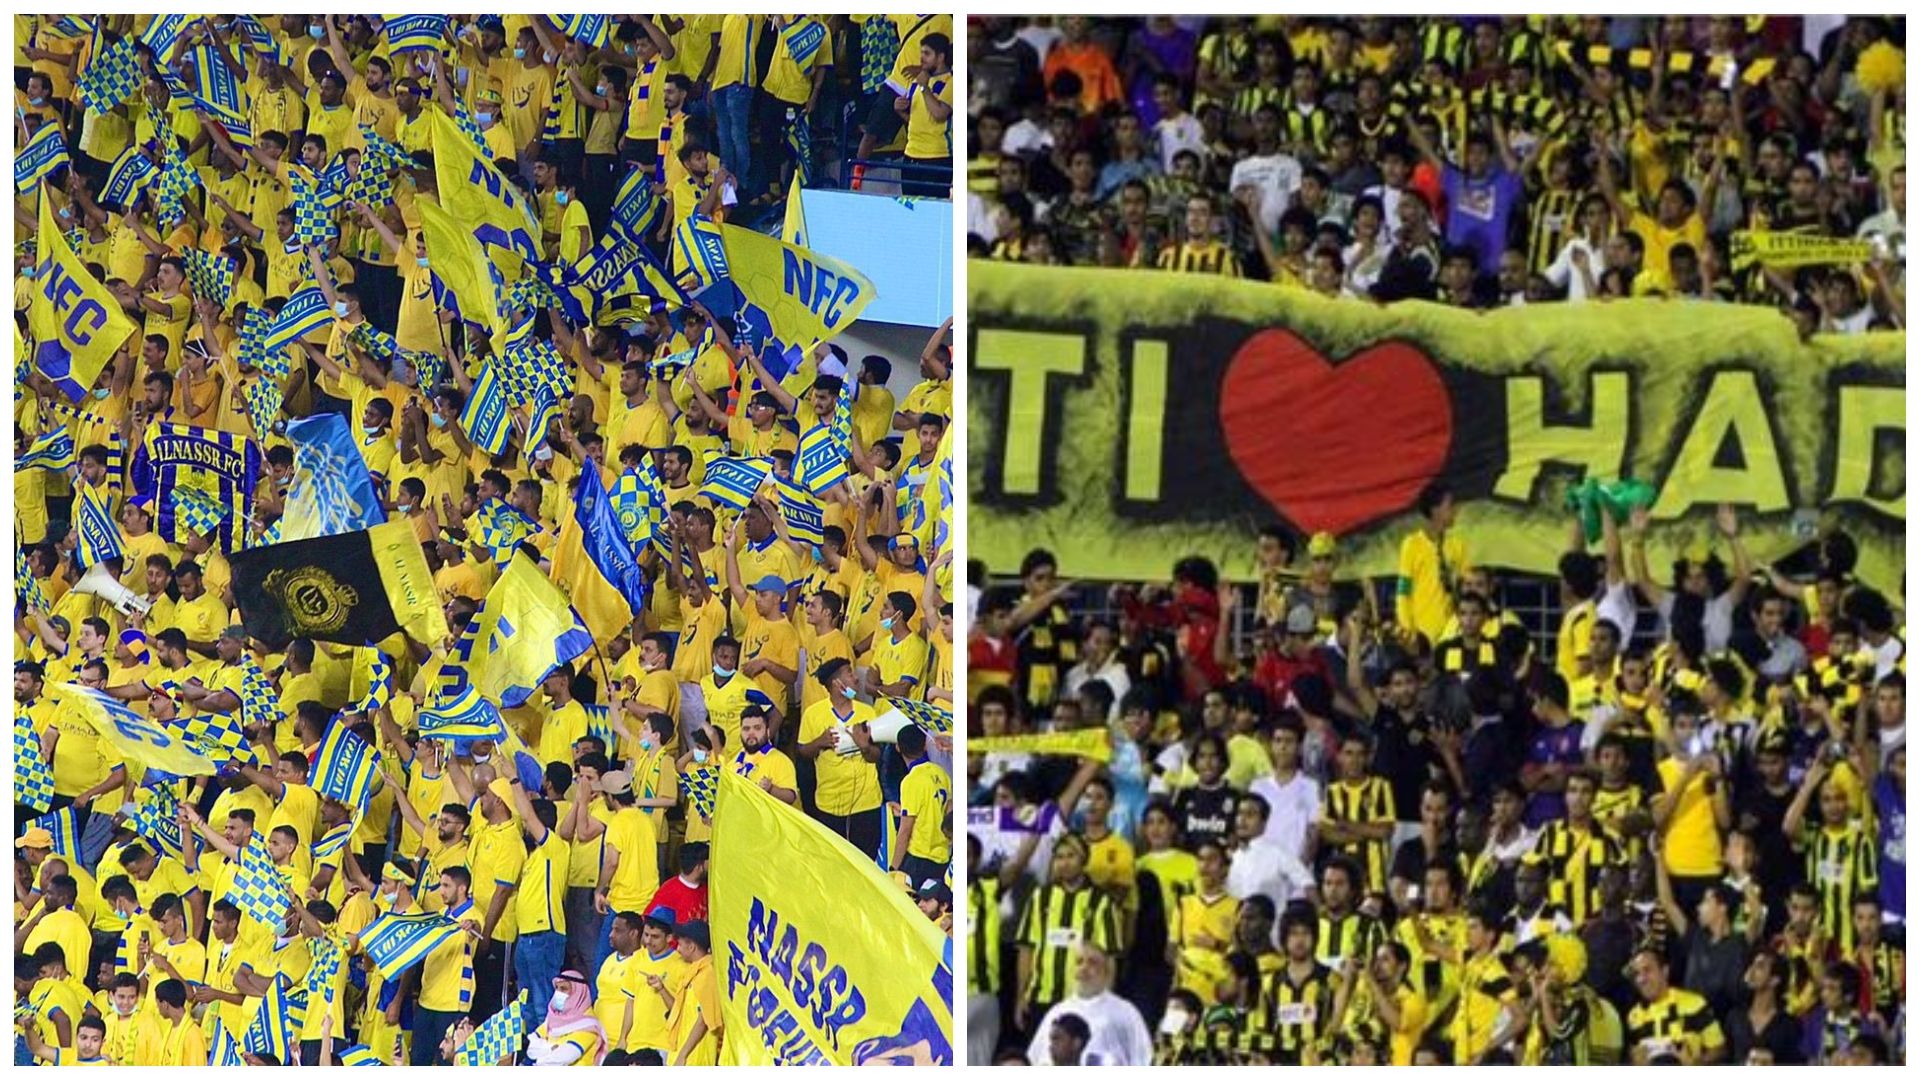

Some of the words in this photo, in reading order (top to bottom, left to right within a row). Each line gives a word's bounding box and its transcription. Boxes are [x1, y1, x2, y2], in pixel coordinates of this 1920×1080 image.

[783, 247, 860, 329] NFC
[975, 329, 1168, 500] TI
[747, 896, 866, 1052] NASSR
